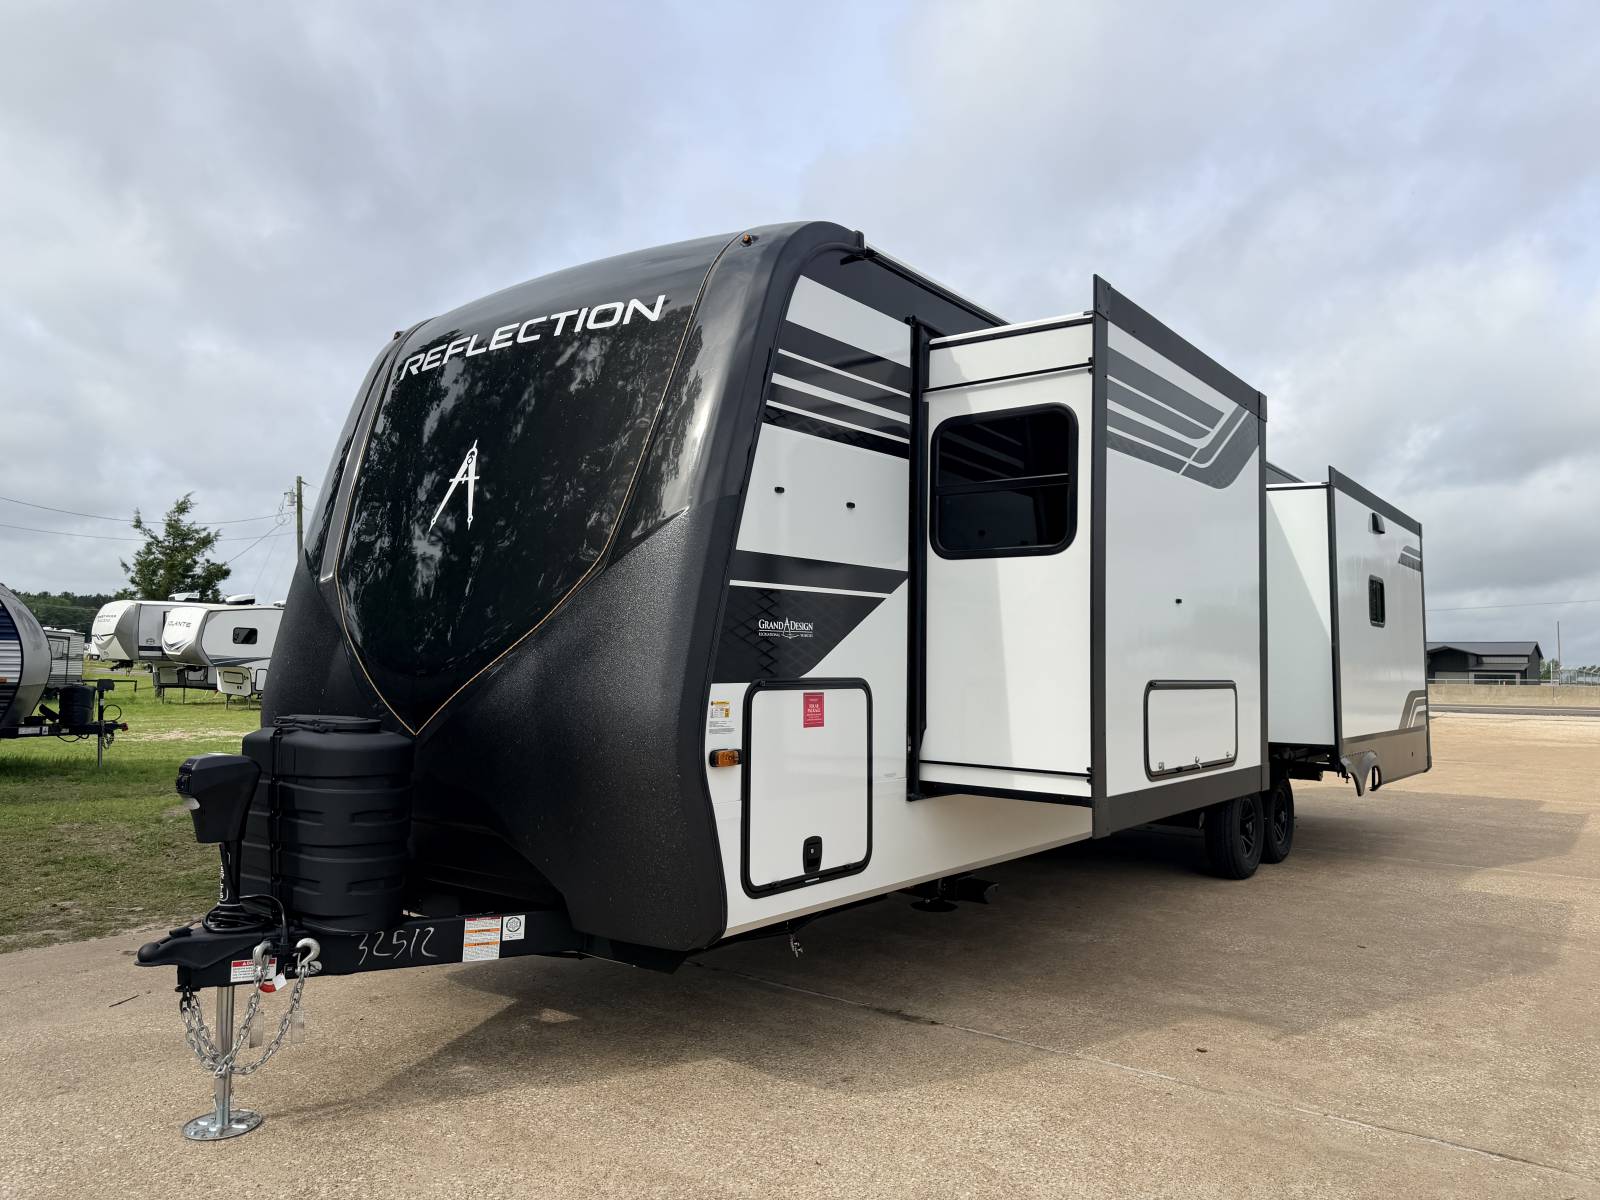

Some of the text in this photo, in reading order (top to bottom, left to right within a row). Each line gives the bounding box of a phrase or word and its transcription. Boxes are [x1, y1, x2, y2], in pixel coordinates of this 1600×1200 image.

[400, 294, 666, 381] REFLECTION
[758, 618, 814, 631] GRAND DESIGN
[351, 927, 439, 966] 32512
